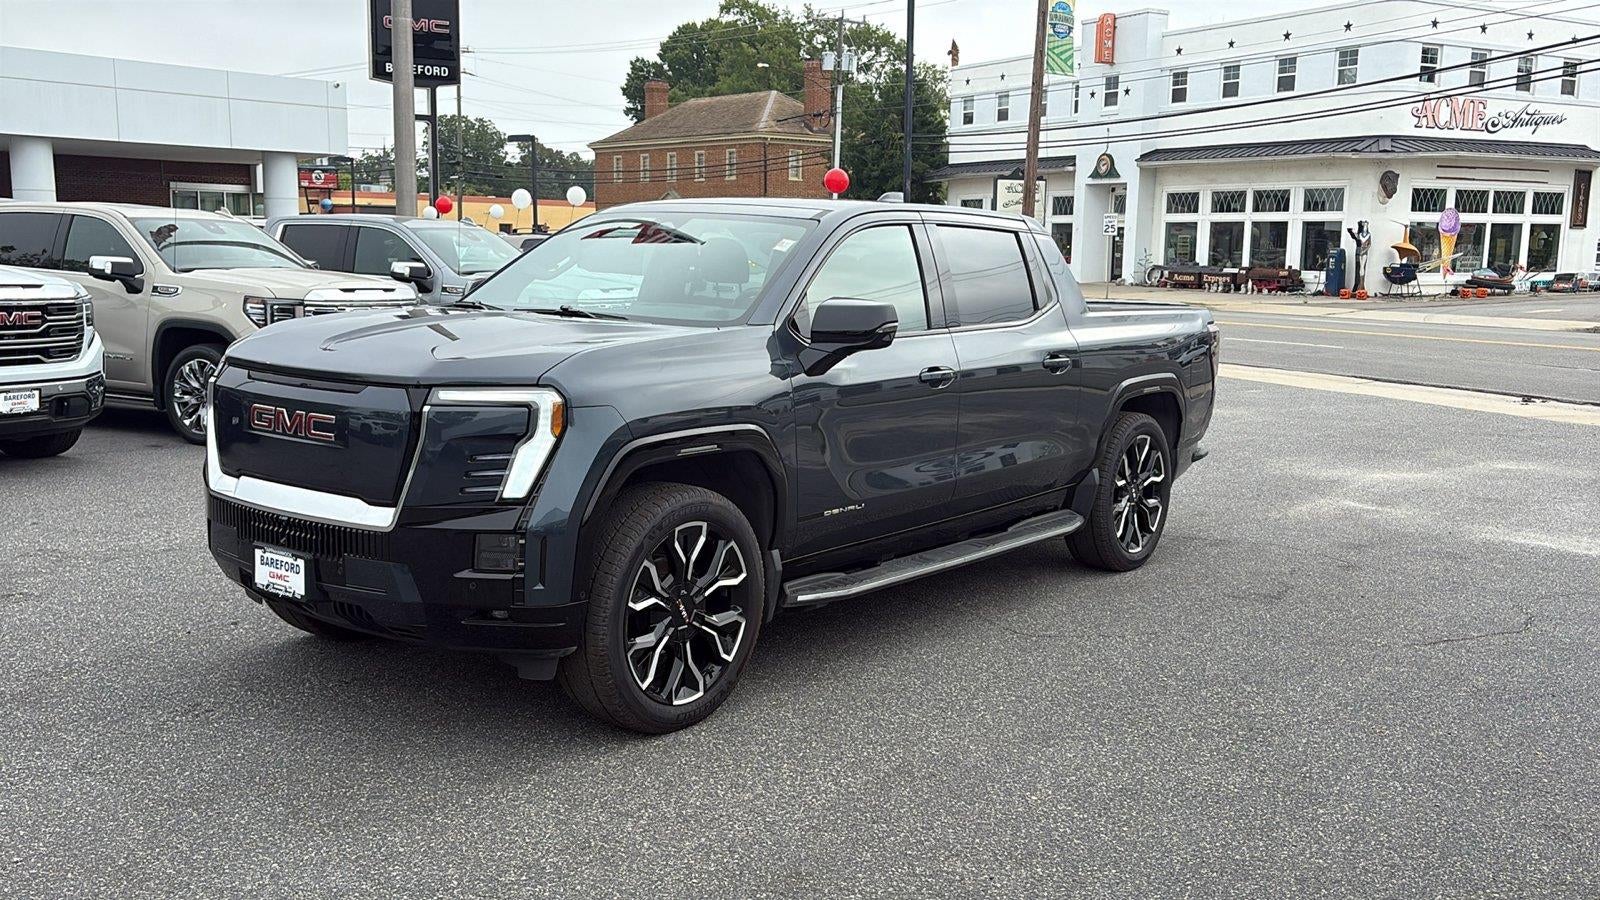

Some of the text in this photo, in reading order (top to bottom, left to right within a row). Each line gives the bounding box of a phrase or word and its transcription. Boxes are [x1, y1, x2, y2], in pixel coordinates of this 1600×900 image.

[1104, 17, 1112, 60] ACME
[385, 62, 449, 77] BEFORD
[1411, 94, 1567, 135] ACME Antiques
[1104, 224, 1116, 234] 25
[1173, 273, 1231, 283] Acme Express
[0, 311, 41, 326] MC
[4, 393, 36, 401] BAREFORD
[250, 403, 336, 441] GMC
[823, 503, 865, 517] DENALI
[260, 555, 301, 575] BAREFORD
[268, 570, 290, 583] GMC
